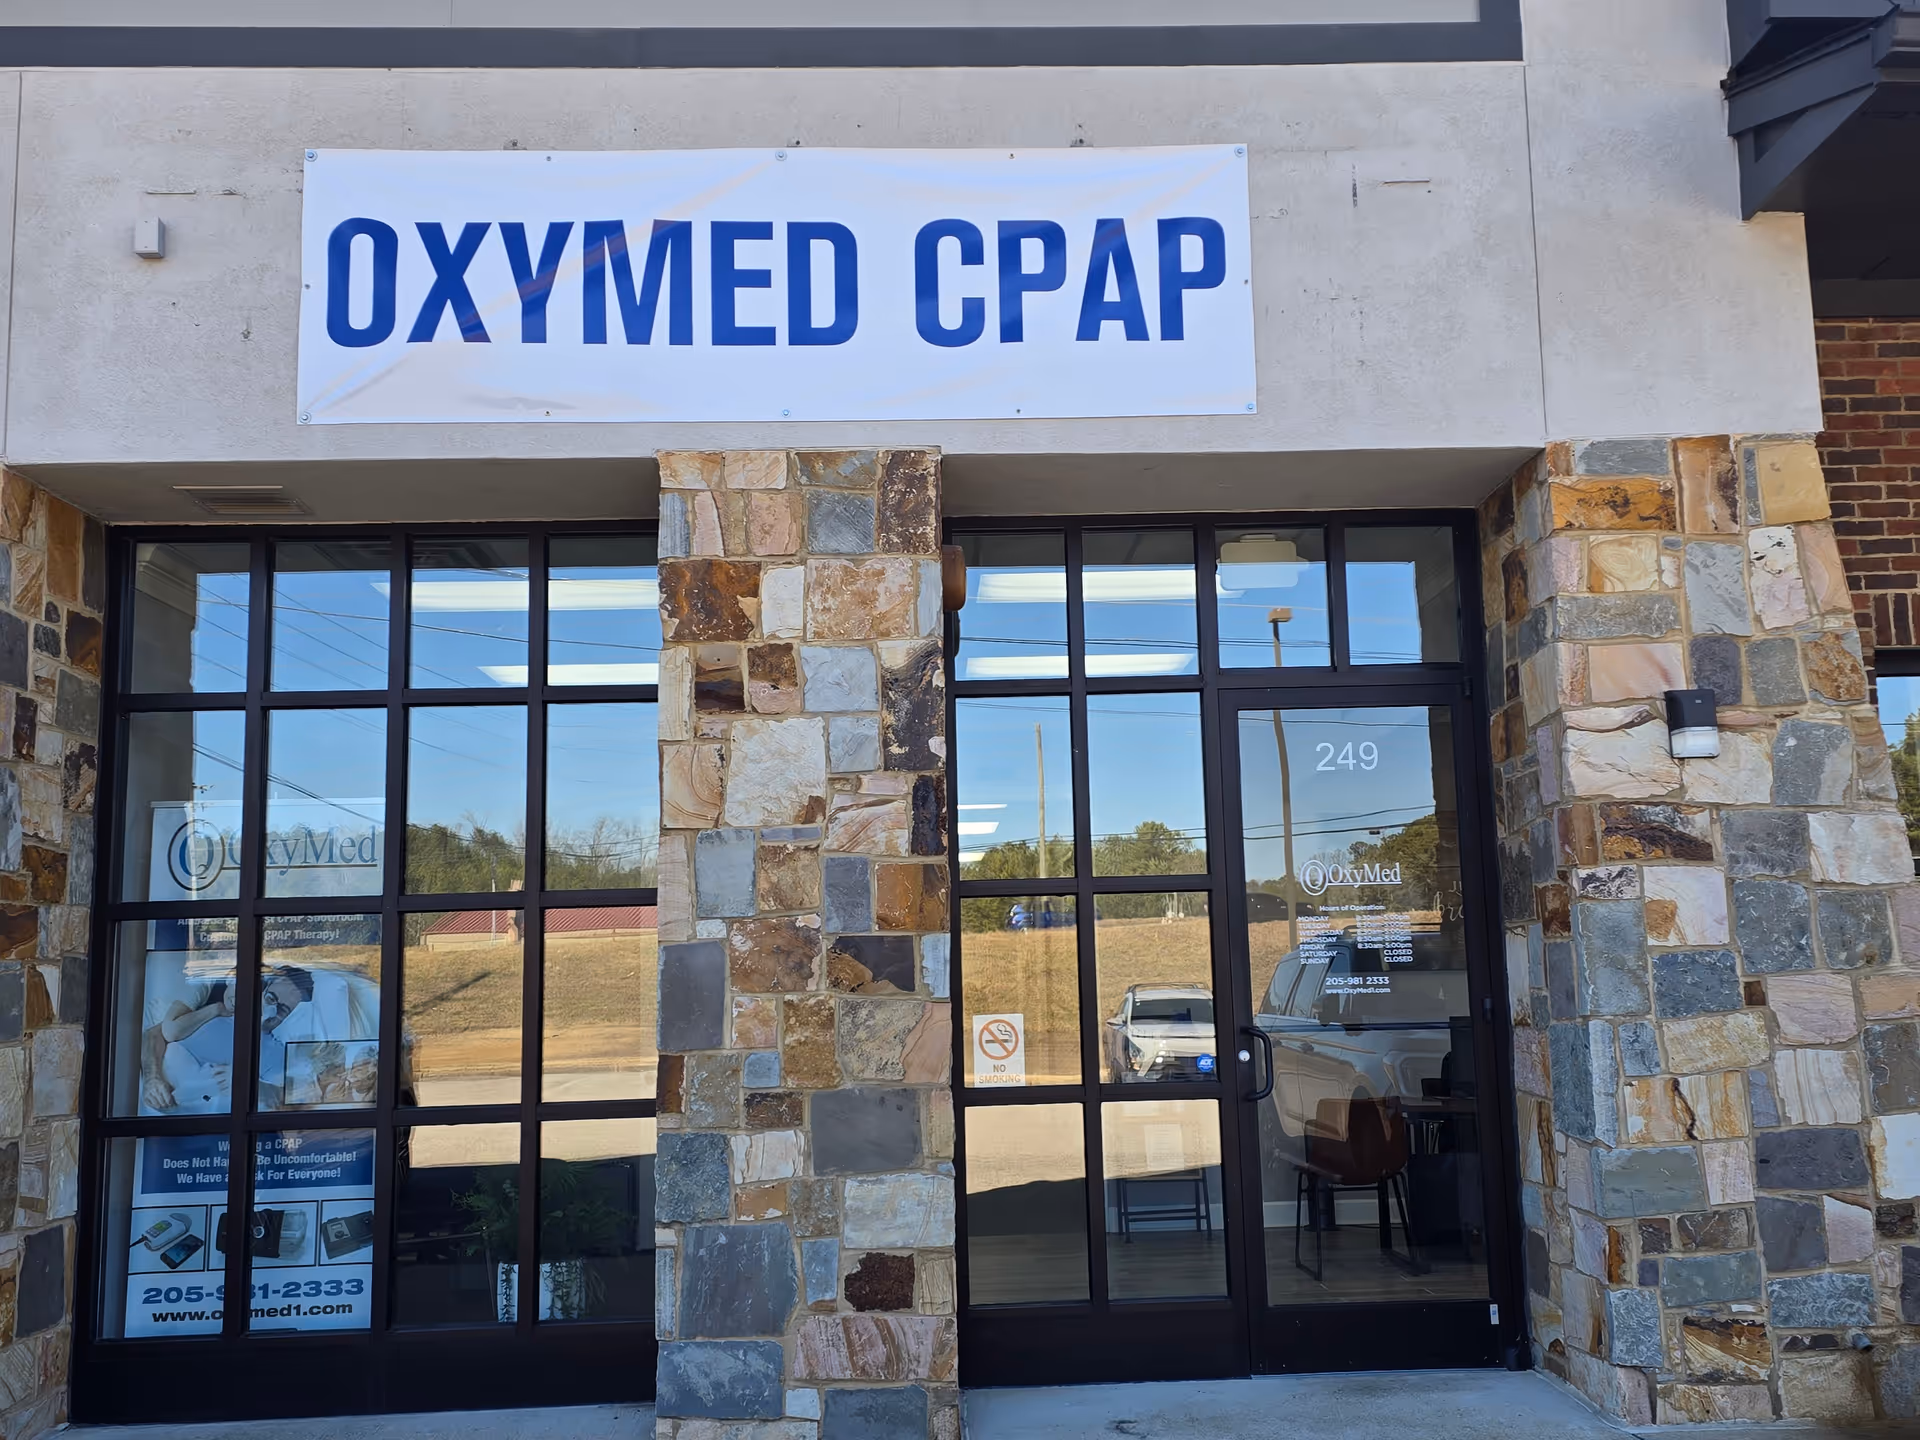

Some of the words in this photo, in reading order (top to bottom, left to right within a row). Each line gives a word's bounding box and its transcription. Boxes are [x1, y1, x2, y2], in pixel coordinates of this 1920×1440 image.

[326, 217, 858, 347] OXYMED
[914, 217, 1226, 347] CPAP
[1315, 741, 1379, 771] 249
[1328, 862, 1401, 888] OxyMed
[264, 930, 292, 941] CPAP
[294, 927, 340, 942] Therapy!
[1325, 977, 1363, 986] 205-981
[1366, 976, 1390, 985] 2333
[993, 1064, 1006, 1073] NO
[978, 1073, 1021, 1084] SMOKING
[265, 1141, 272, 1150] a
[274, 1138, 303, 1150] CPAP
[163, 1158, 189, 1169] Does
[192, 1157, 211, 1168] Not
[213, 1156, 230, 1168] Ha
[257, 1154, 271, 1166] Be
[274, 1150, 357, 1165] Uncomfortable!
[177, 1173, 193, 1184] We
[195, 1172, 222, 1184] Have
[267, 1169, 285, 1181] For
[288, 1167, 341, 1180] Everyone!
[141, 1278, 364, 1304] 205-1-2333
[152, 1303, 353, 1323] www.omed1.com
